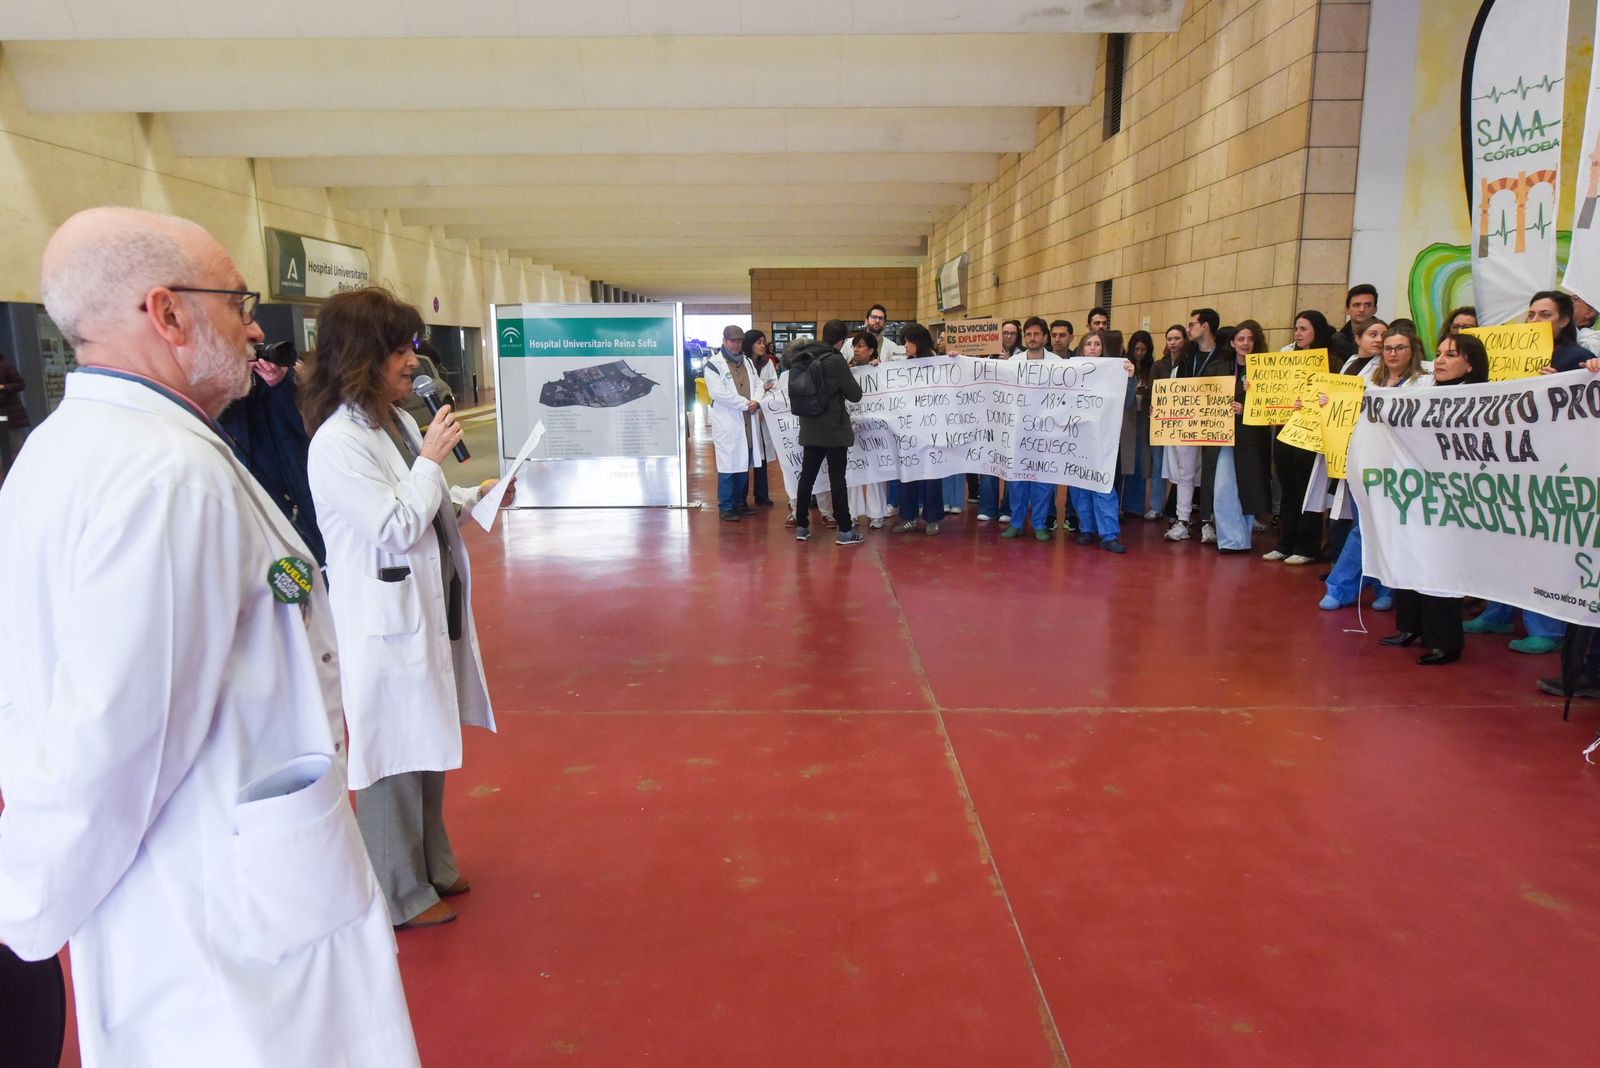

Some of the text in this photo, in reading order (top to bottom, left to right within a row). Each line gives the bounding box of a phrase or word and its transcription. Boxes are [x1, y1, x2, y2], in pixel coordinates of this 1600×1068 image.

[1477, 109, 1548, 146] SMA
[1483, 137, 1560, 161] CÓRDOBA
[308, 261, 367, 280] Hospital Universitario
[947, 325, 957, 333] NO
[958, 325, 966, 333] ES
[529, 339, 561, 350] Hospital
[563, 339, 612, 348] Universitario
[614, 339, 636, 348] Reina
[637, 338, 657, 348] Sofía
[947, 335, 956, 344] ES
[1485, 329, 1540, 351] CONDUCIR
[1264, 356, 1276, 366] UN
[1279, 355, 1324, 367] CONDUCTOR
[886, 363, 961, 389] ESTATUTO
[974, 361, 1007, 382] DEL
[1253, 370, 1291, 380] AGOTADO
[1155, 381, 1222, 393] UN CONDUCTOR
[889, 396, 906, 411] LOS
[956, 391, 986, 406] SOMOS
[993, 390, 1014, 405] SOLO
[1017, 393, 1032, 407] EL
[1076, 394, 1103, 409] ESTO
[1157, 396, 1167, 406] NO
[1172, 395, 1200, 406] PUEDE
[1253, 397, 1262, 405] UN
[1388, 398, 1420, 427] UN
[1421, 390, 1539, 428] ESTATUTO
[1154, 407, 1233, 418] 24 HORAS SEGUIDAS
[1251, 409, 1261, 417] EN
[1264, 409, 1277, 417] UNA
[898, 415, 912, 429] DE
[920, 413, 937, 428] 100
[1023, 414, 1056, 432] SOLO
[1063, 415, 1082, 438] 18
[1161, 420, 1183, 428] PERO
[931, 433, 938, 447] Y
[946, 429, 994, 448] NECESITAN
[1001, 432, 1011, 449] EL
[1435, 430, 1539, 463] PARA LA
[876, 455, 894, 468] LOS
[1020, 458, 1058, 473] SALIMOS
[1064, 462, 1110, 484] PERDIENDO
[1363, 462, 1523, 506] PROFESIÓN
[1391, 496, 1413, 525] Y
[279, 559, 312, 593] HUELGA
[1578, 599, 1587, 607] DE
